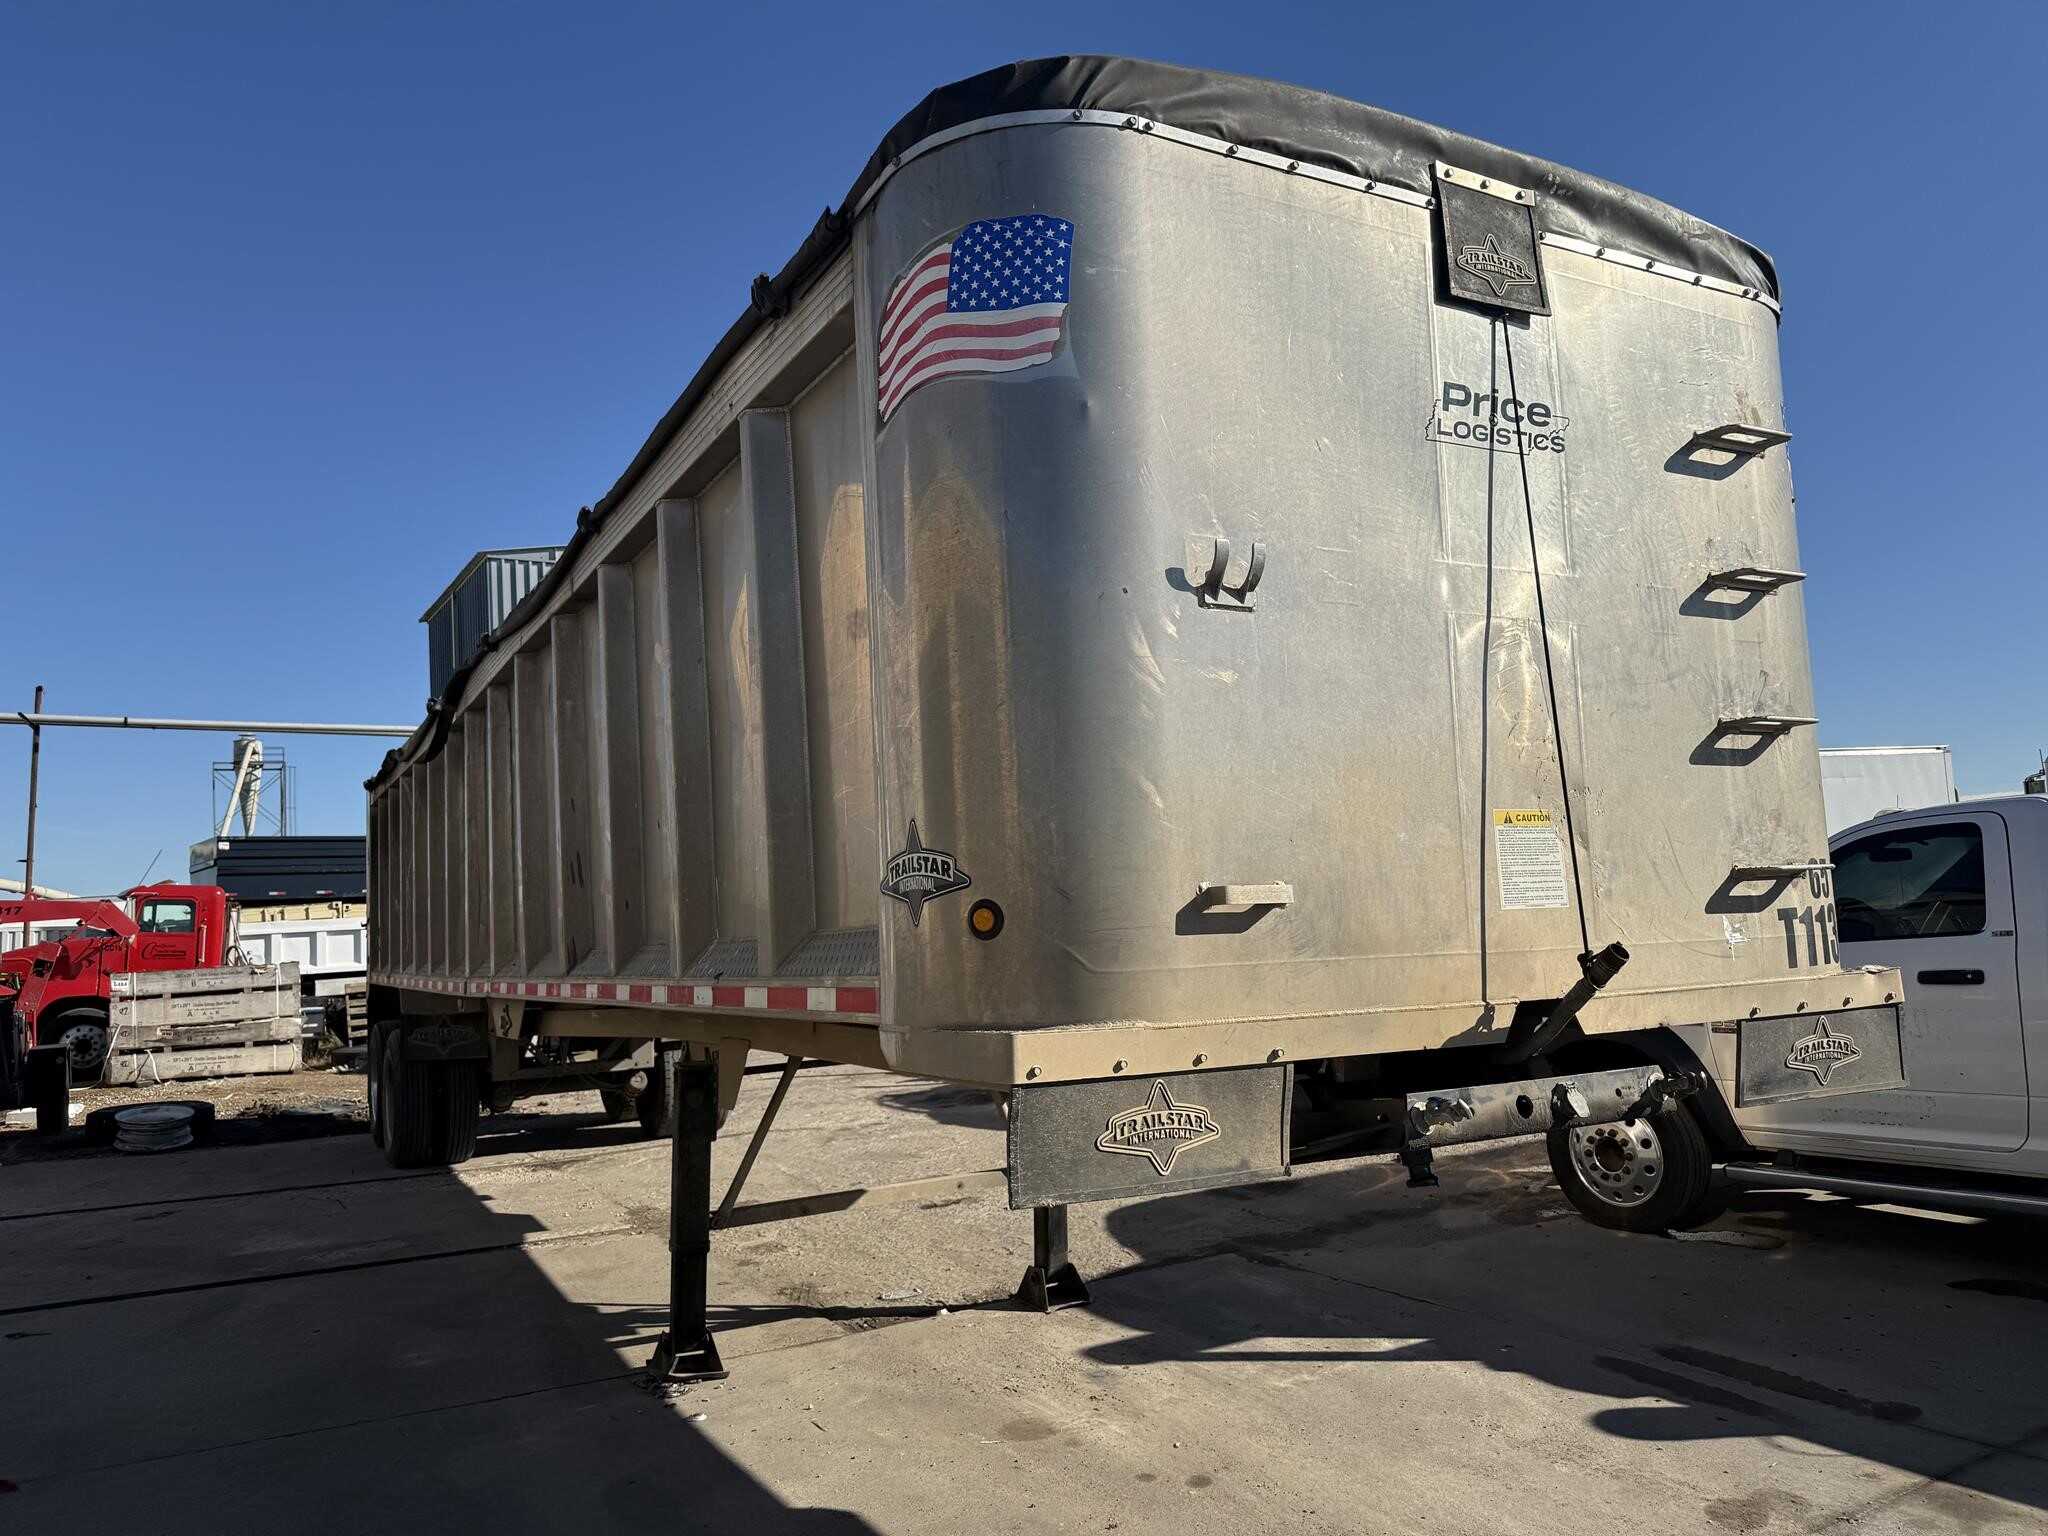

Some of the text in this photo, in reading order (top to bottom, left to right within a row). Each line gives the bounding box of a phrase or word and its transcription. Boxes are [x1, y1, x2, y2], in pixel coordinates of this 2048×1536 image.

[1467, 252, 1524, 275] TRAILSTAR
[1442, 381, 1552, 427] Price
[1437, 418, 1566, 453] LOGISTICS
[1515, 813, 1551, 823] CAUTION
[889, 855, 952, 883] TRAILSTAR
[899, 876, 936, 893] INTERNATIONAL
[1799, 1040, 1850, 1057] TRAILSTAR
[1117, 1112, 1204, 1137] TRAILSTAR
[1129, 1129, 1195, 1146] INTERNATIONAL
